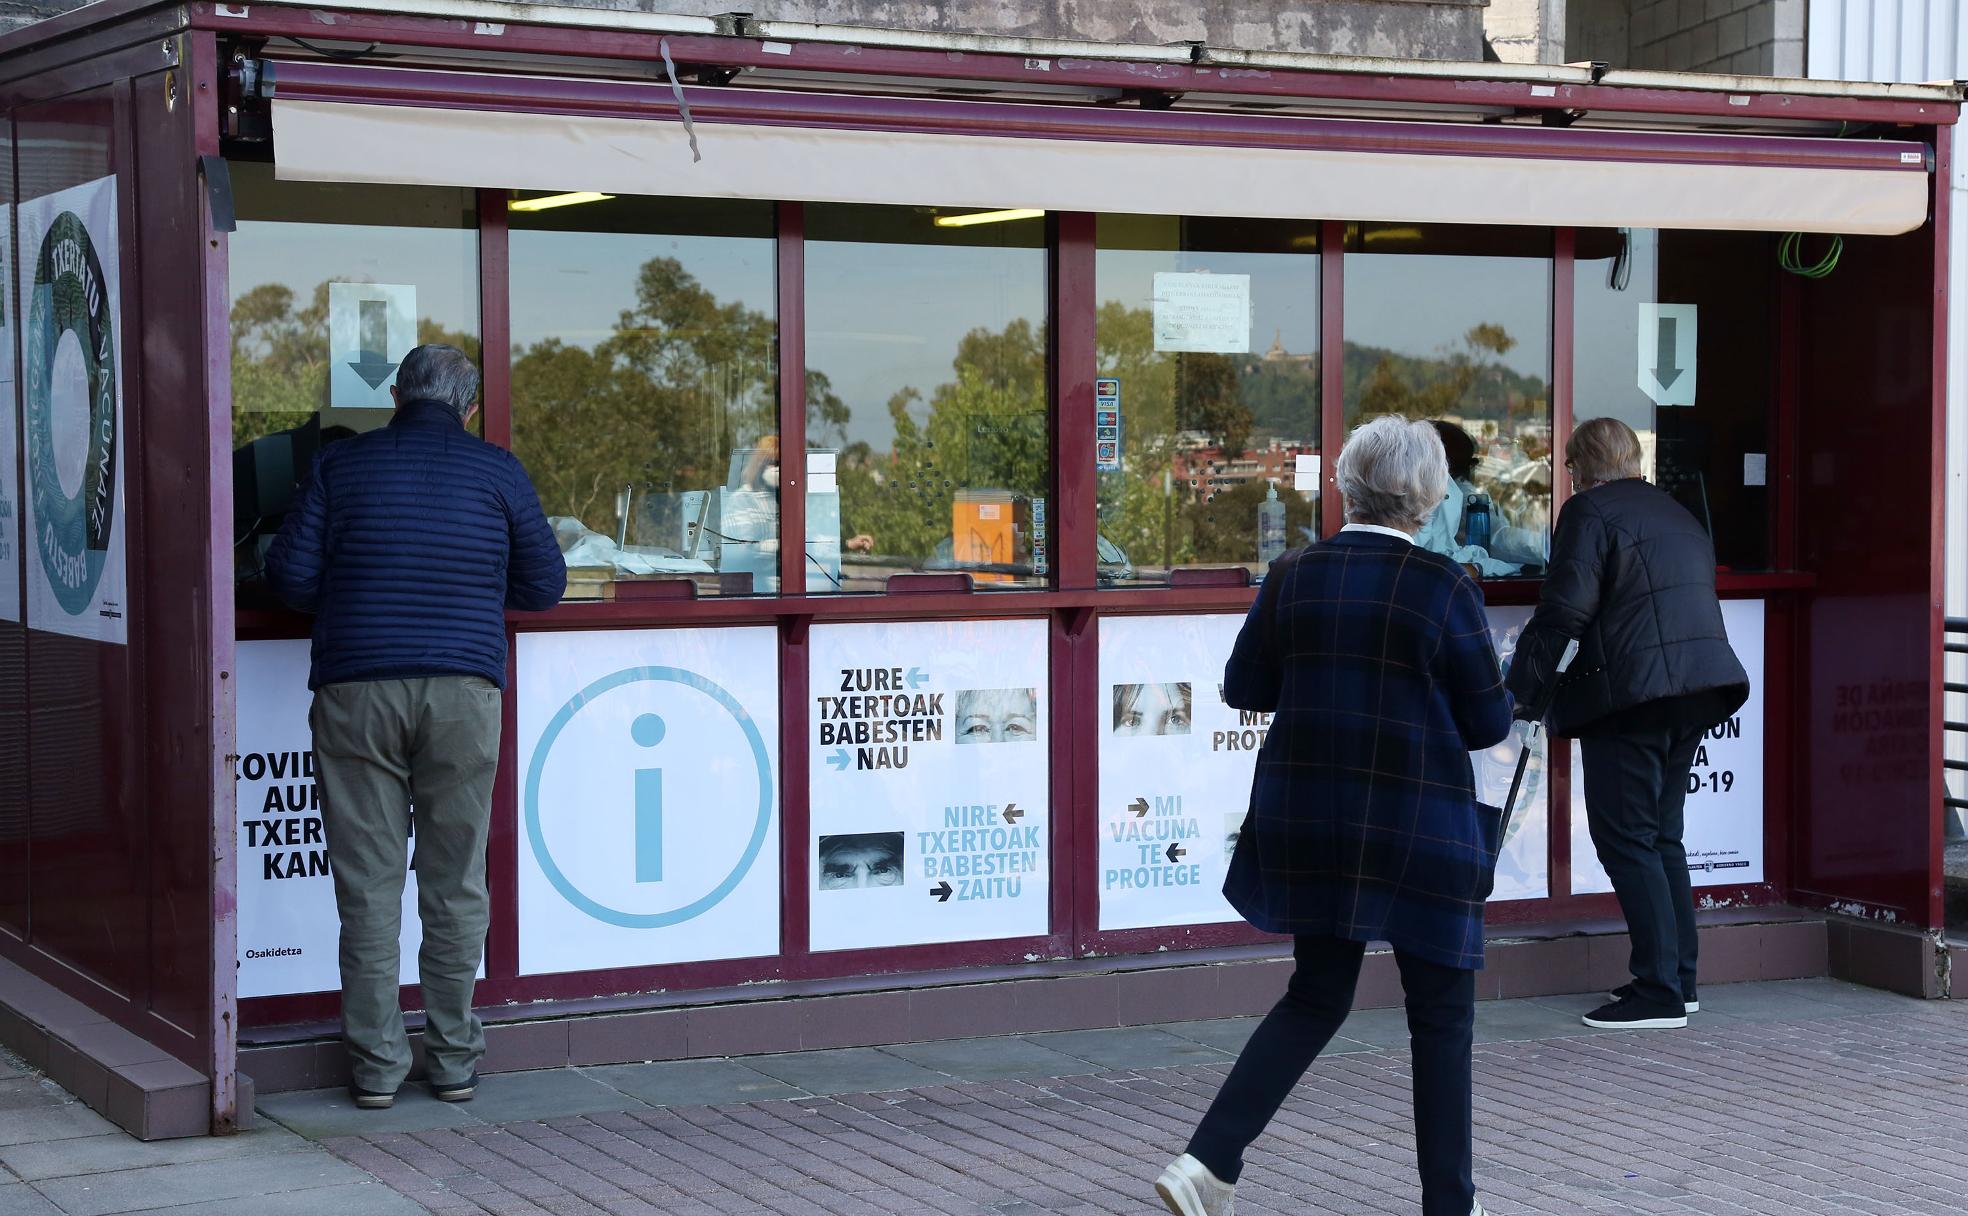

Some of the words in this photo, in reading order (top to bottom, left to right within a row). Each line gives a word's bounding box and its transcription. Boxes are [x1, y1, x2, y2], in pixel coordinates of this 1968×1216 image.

[52, 239, 99, 317] TXERTATU
[92, 335, 113, 540] VACÚNATE
[45, 521, 88, 588] BABESTU
[841, 668, 903, 691] ZURE
[818, 693, 944, 719] TXERTOAK
[820, 719, 942, 745] BABESTEN
[857, 746, 908, 770] NAU
[944, 805, 998, 827] NIRE
[1155, 795, 1182, 816] MI
[917, 826, 1040, 854] TXERTOAK
[1110, 818, 1200, 842] VACUNA
[924, 851, 1037, 878] BABESTEN
[1138, 844, 1161, 864] TE
[957, 877, 1021, 900] ZAITU
[1106, 864, 1200, 890] PROTEGE
[246, 947, 302, 958] Osakidetza
